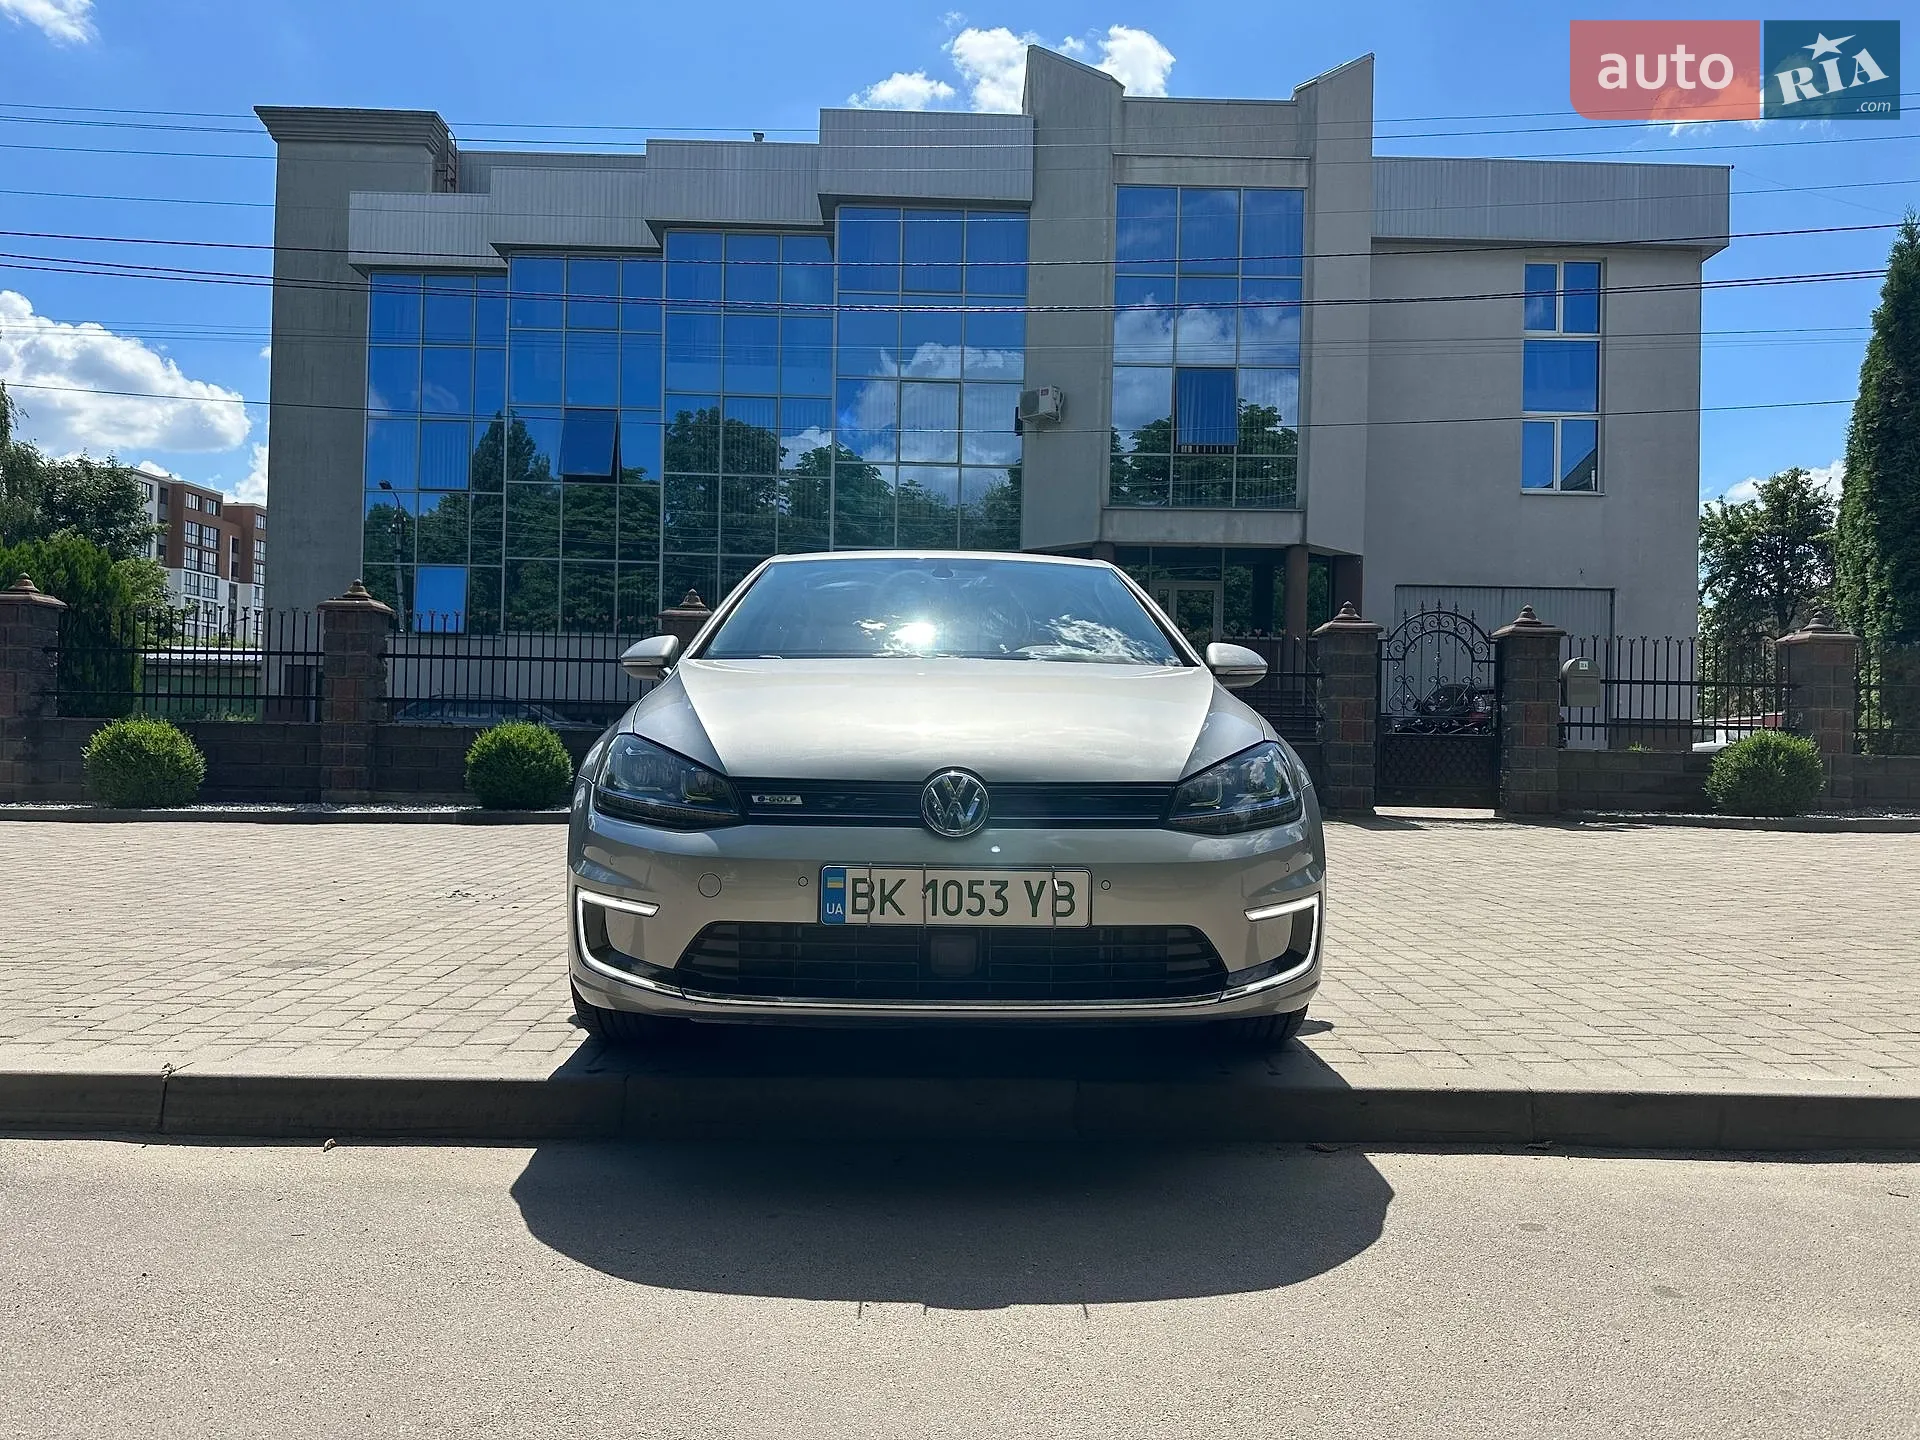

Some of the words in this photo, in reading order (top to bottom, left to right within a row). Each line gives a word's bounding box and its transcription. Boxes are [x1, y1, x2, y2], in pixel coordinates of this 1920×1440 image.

[826, 902, 844, 915] UA
[851, 877, 906, 916] BK
[923, 878, 1009, 917] 1053
[1024, 880, 1076, 918] YB
